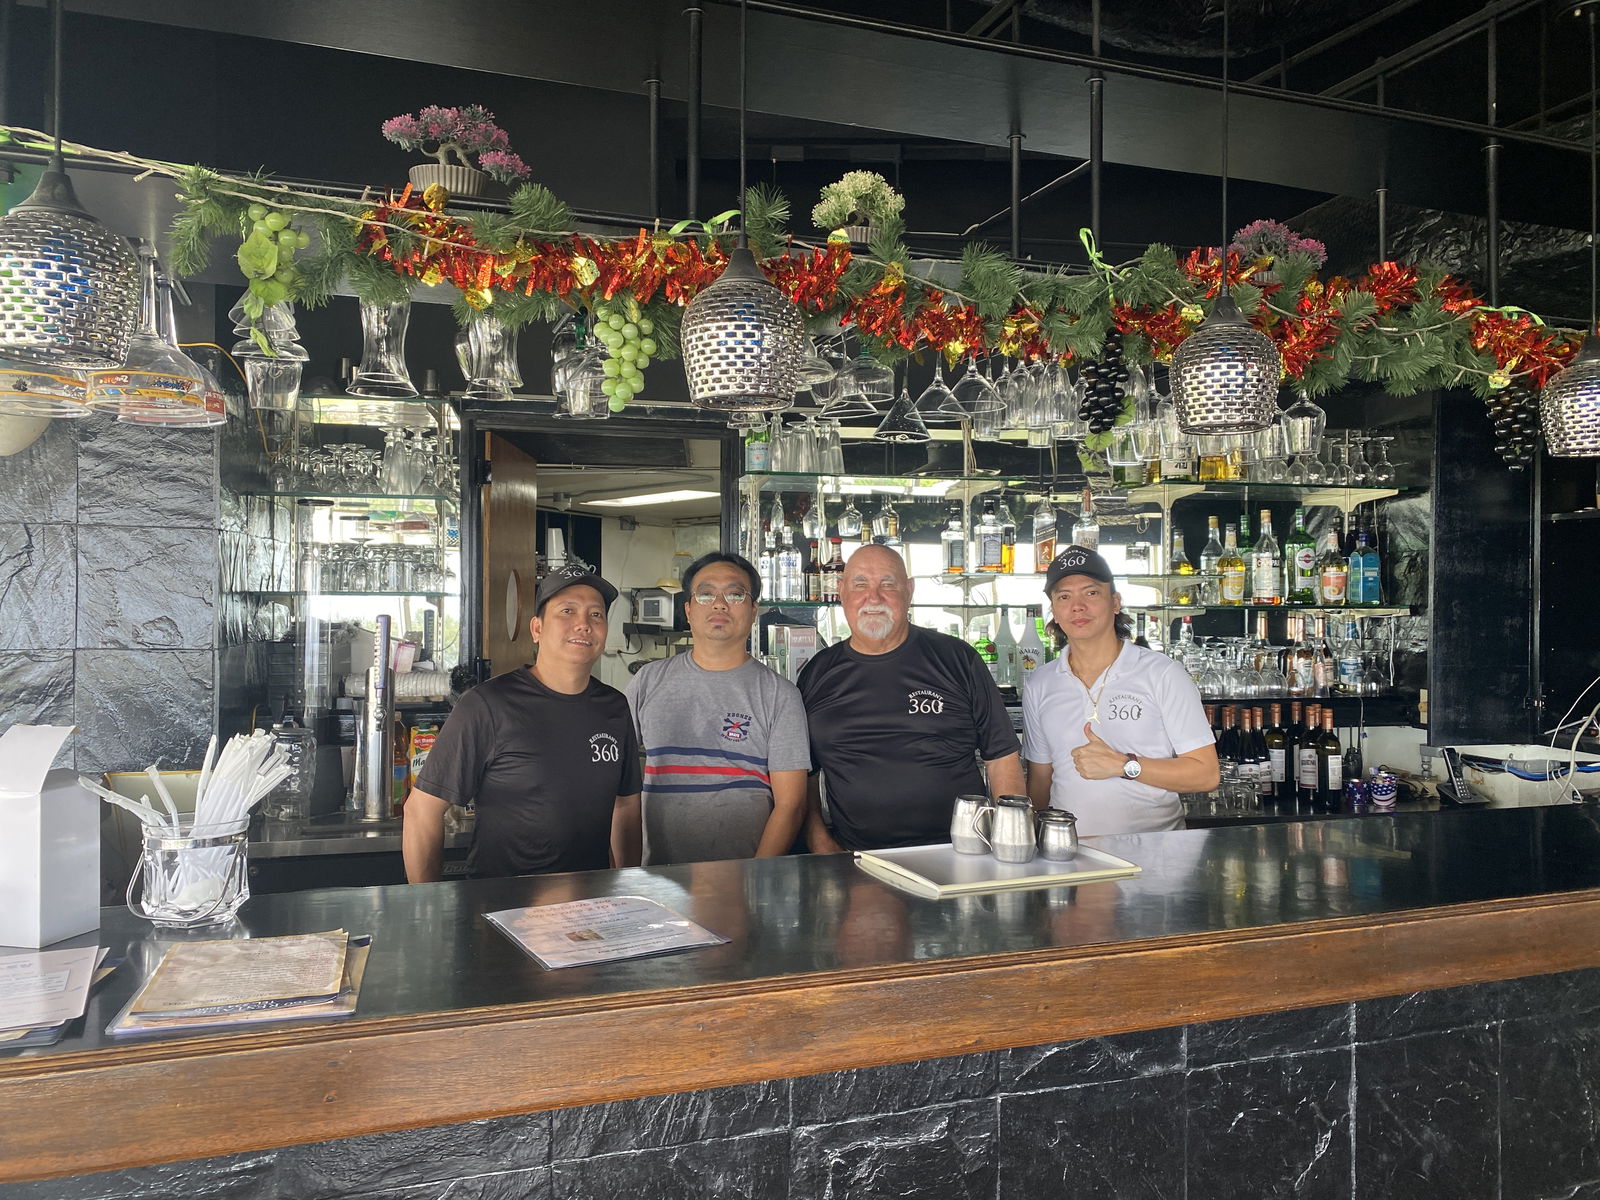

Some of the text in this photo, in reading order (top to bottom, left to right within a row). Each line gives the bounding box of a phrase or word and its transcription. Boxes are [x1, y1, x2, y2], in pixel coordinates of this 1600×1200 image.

[1060, 556, 1086, 570] 360
[908, 690, 944, 700] RESTAURANT
[908, 698, 944, 714] 360
[1108, 704, 1142, 720] 360
[589, 733, 617, 744] RESTAURANT
[590, 744, 619, 762] 360
[412, 759, 425, 767] Ma
